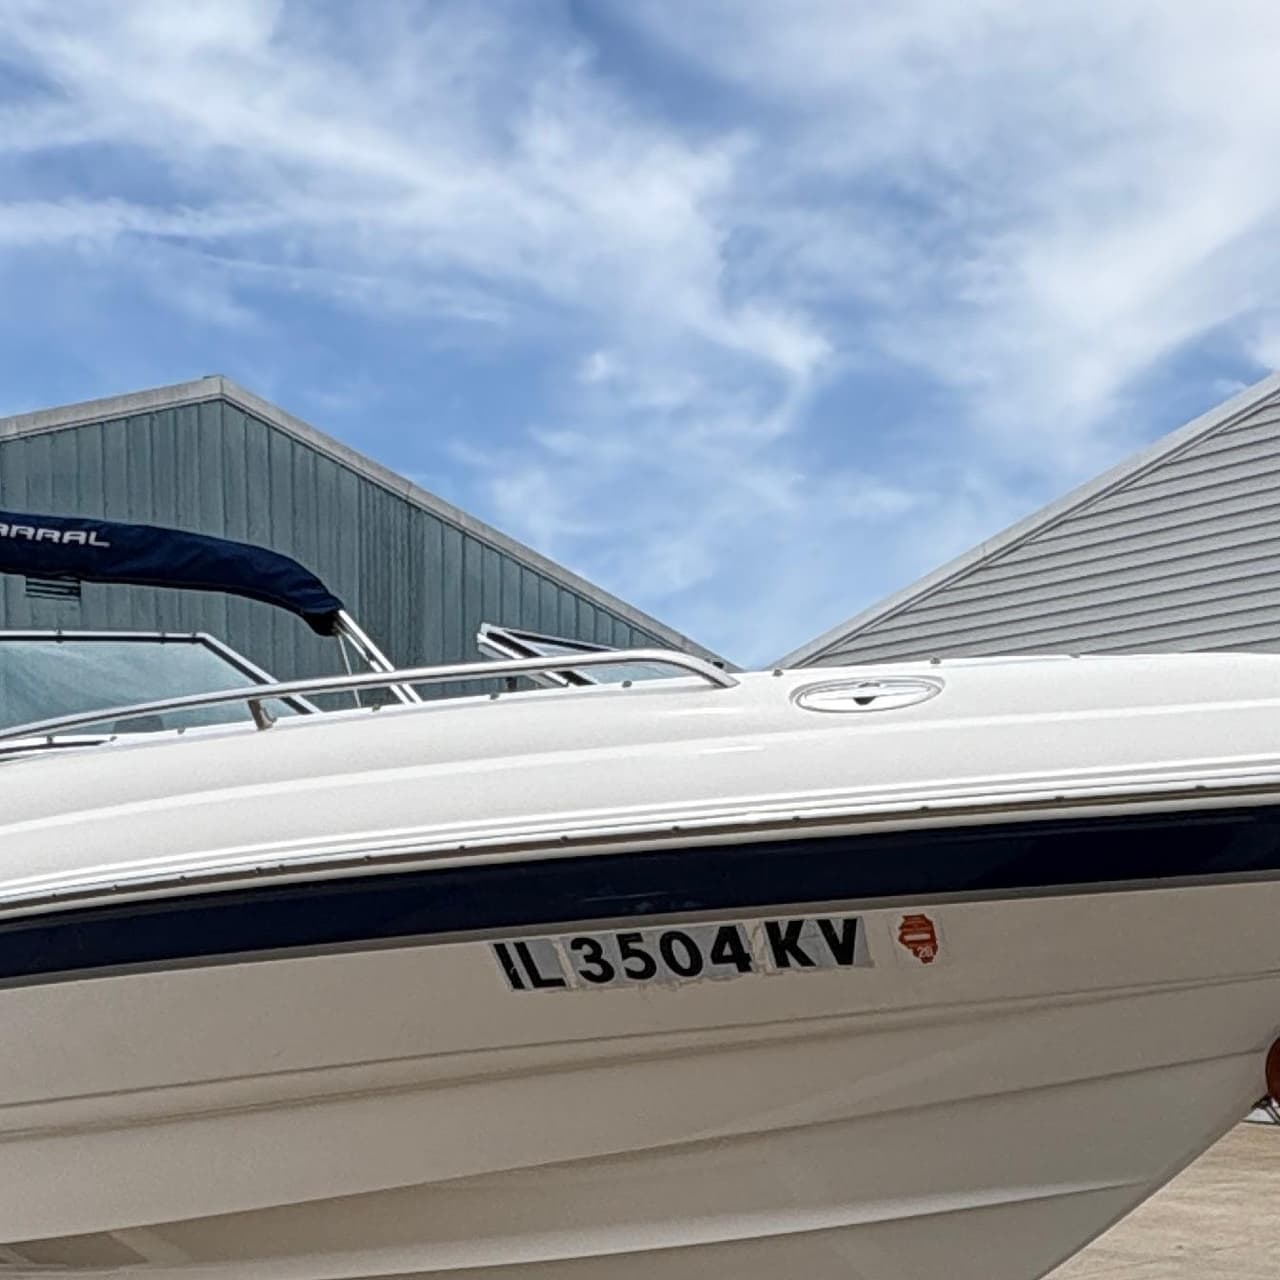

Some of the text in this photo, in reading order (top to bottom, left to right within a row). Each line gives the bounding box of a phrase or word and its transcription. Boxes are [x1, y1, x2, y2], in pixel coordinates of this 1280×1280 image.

[492, 917, 862, 990] IL 3504 KV
